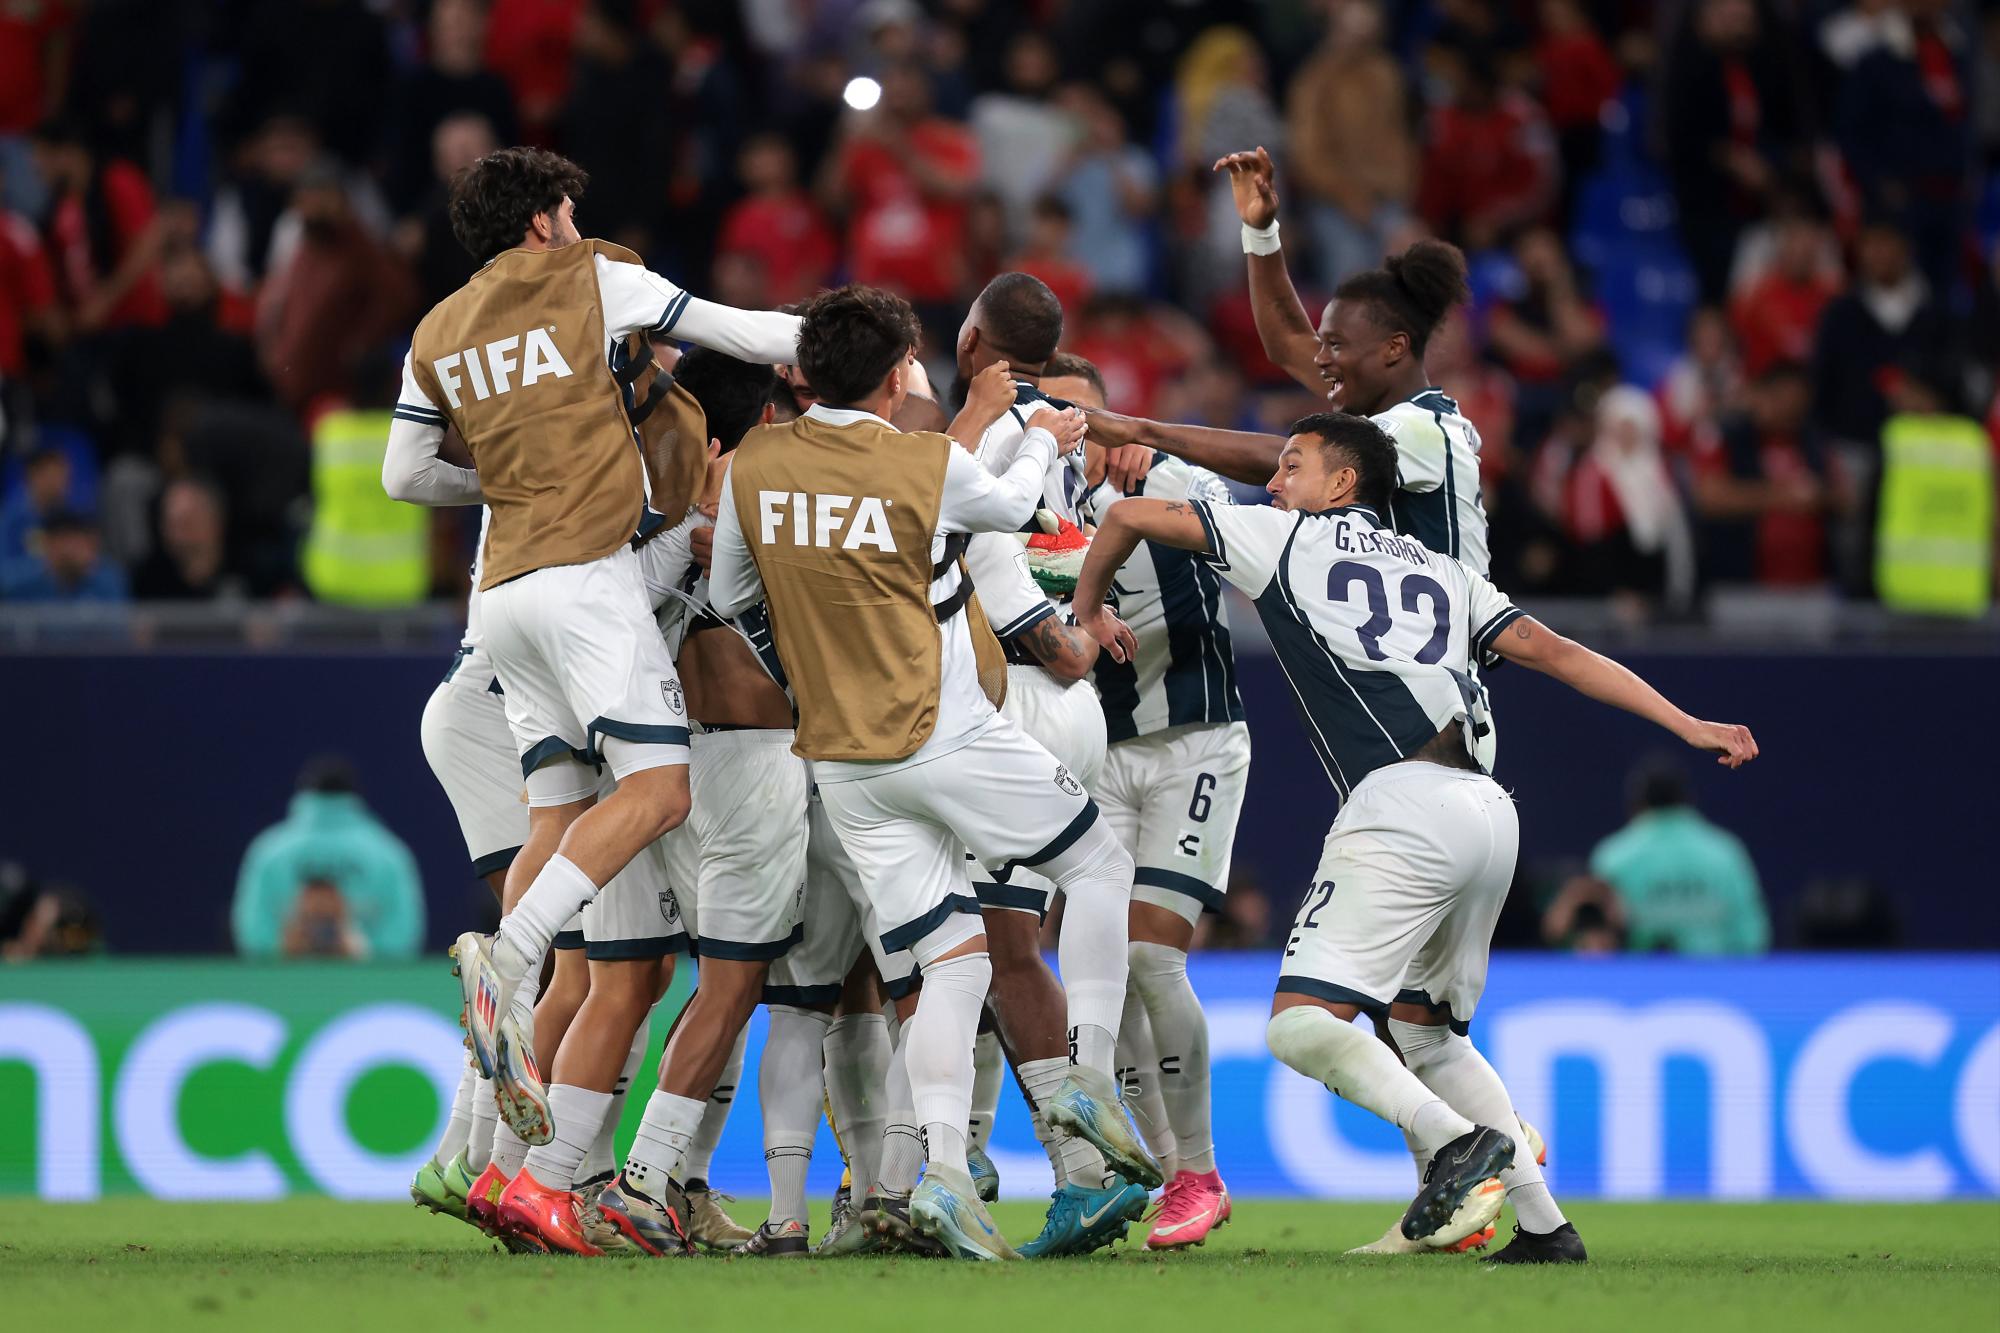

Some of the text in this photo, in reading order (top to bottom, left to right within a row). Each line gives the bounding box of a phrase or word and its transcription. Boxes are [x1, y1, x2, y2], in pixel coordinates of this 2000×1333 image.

[433, 328, 573, 409] FIFA
[759, 490, 898, 553] FIFA
[1188, 772, 1216, 823] 6
